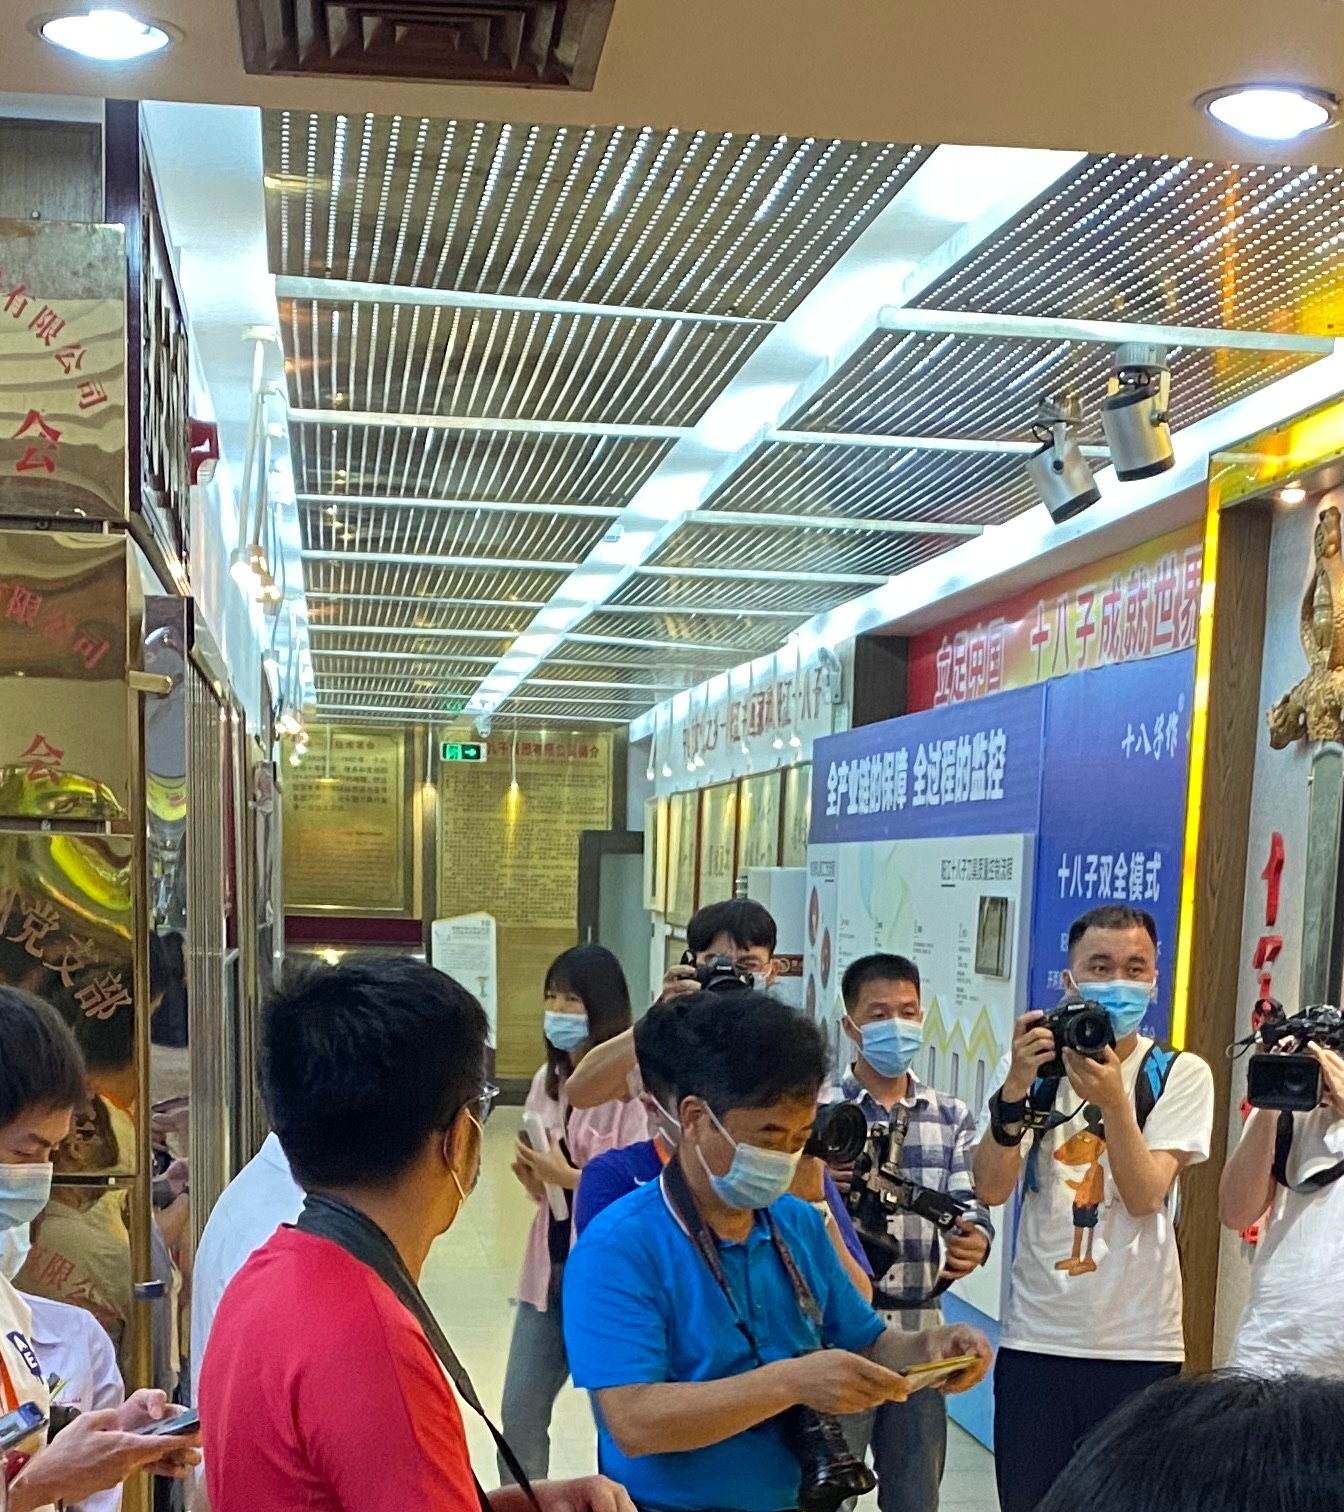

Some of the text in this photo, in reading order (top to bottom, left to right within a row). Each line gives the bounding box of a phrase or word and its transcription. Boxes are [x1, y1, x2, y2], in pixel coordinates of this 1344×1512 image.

[935, 620, 1005, 705] 立足中国
[1121, 711, 1179, 760] 十八子作
[826, 728, 1006, 815] 全产业链的保障 全过程的监控
[1058, 852, 1162, 901] 十八子双全模式
